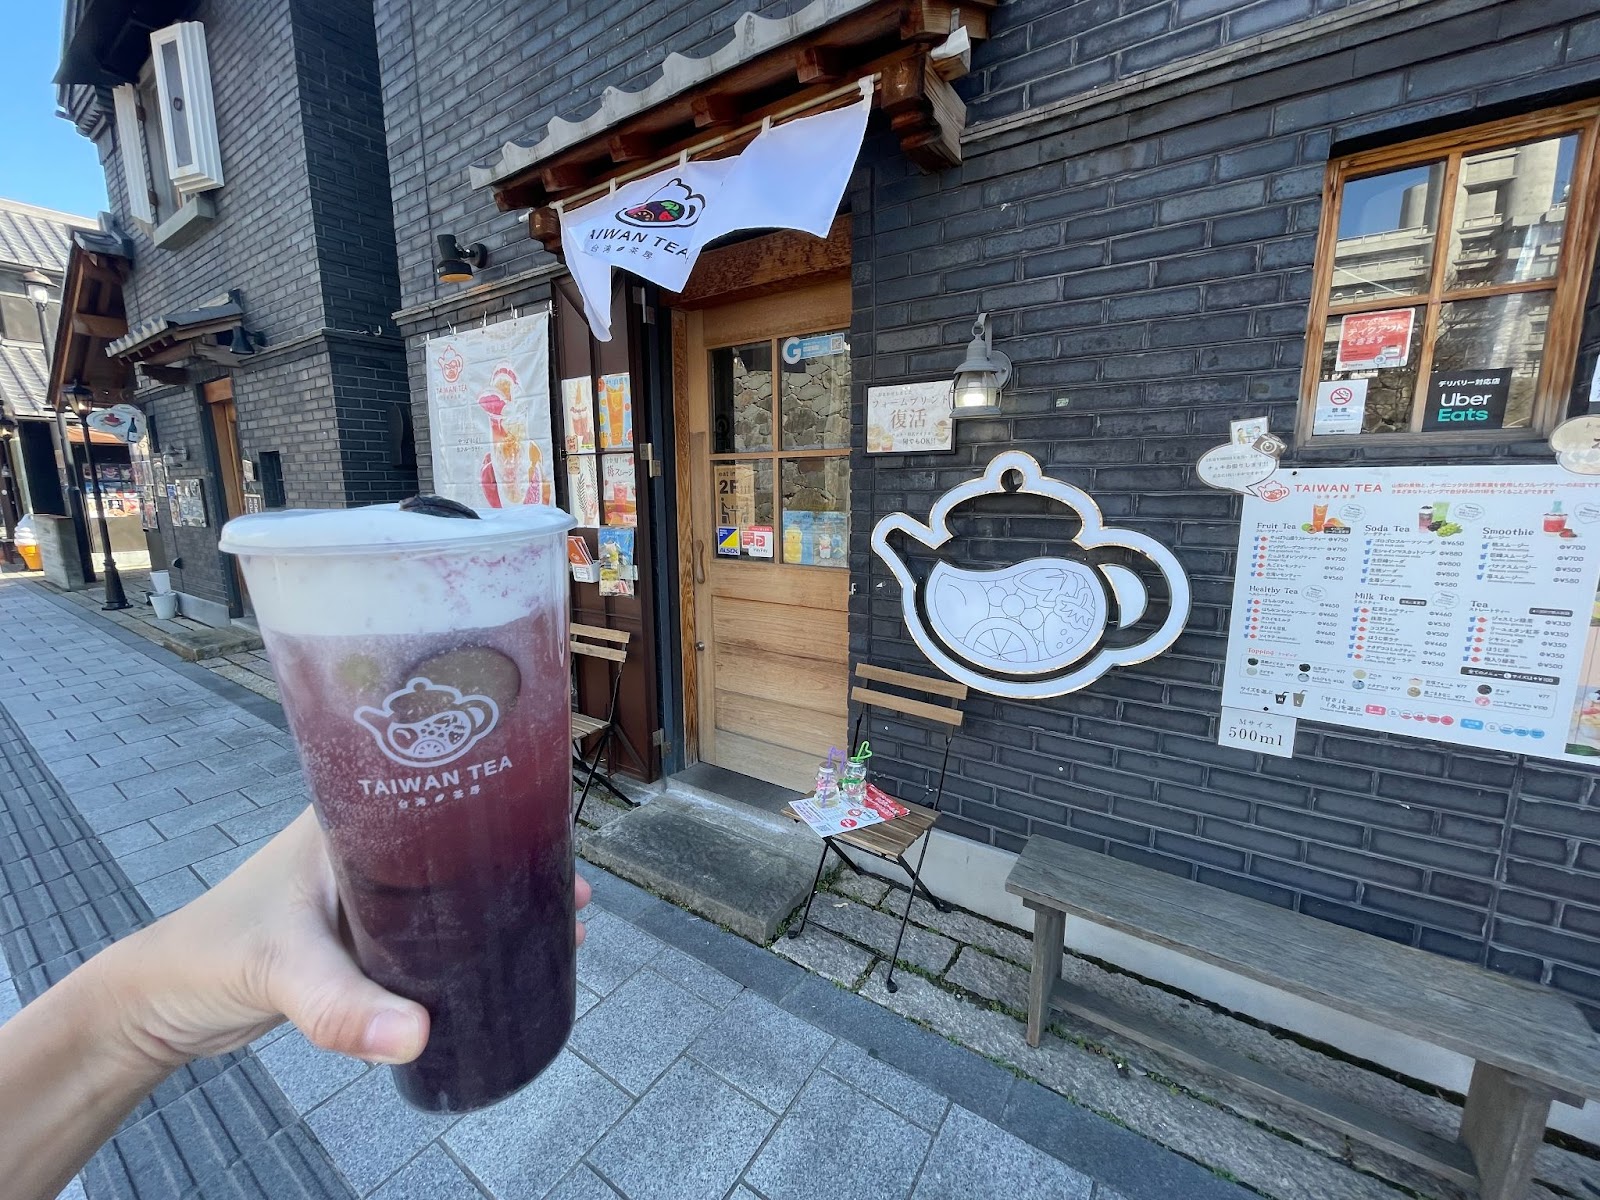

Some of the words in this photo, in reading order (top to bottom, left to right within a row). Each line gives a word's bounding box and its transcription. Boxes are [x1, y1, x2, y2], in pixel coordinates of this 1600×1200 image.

[654, 236, 689, 257] TEA
[1348, 324, 1403, 336] テイクアウト
[1348, 336, 1386, 346] できます
[1438, 378, 1500, 387] デリバリー対応店
[872, 395, 948, 408] フォームプリント
[1441, 393, 1492, 406] Uber
[891, 408, 926, 428] 復活
[1438, 407, 1489, 422] Eats
[719, 480, 738, 494] 2F
[1295, 484, 1350, 493] TAIWAN
[1354, 484, 1382, 493] TEA
[1482, 527, 1534, 536] Smoothie
[1249, 586, 1280, 594] Healthy
[1355, 592, 1374, 600] Milk
[1471, 600, 1488, 608] Tea
[1239, 719, 1273, 729] Mサイズ
[1229, 727, 1282, 746] 500ml
[358, 770, 459, 795] TAIWAN
[468, 756, 513, 780] TEA
